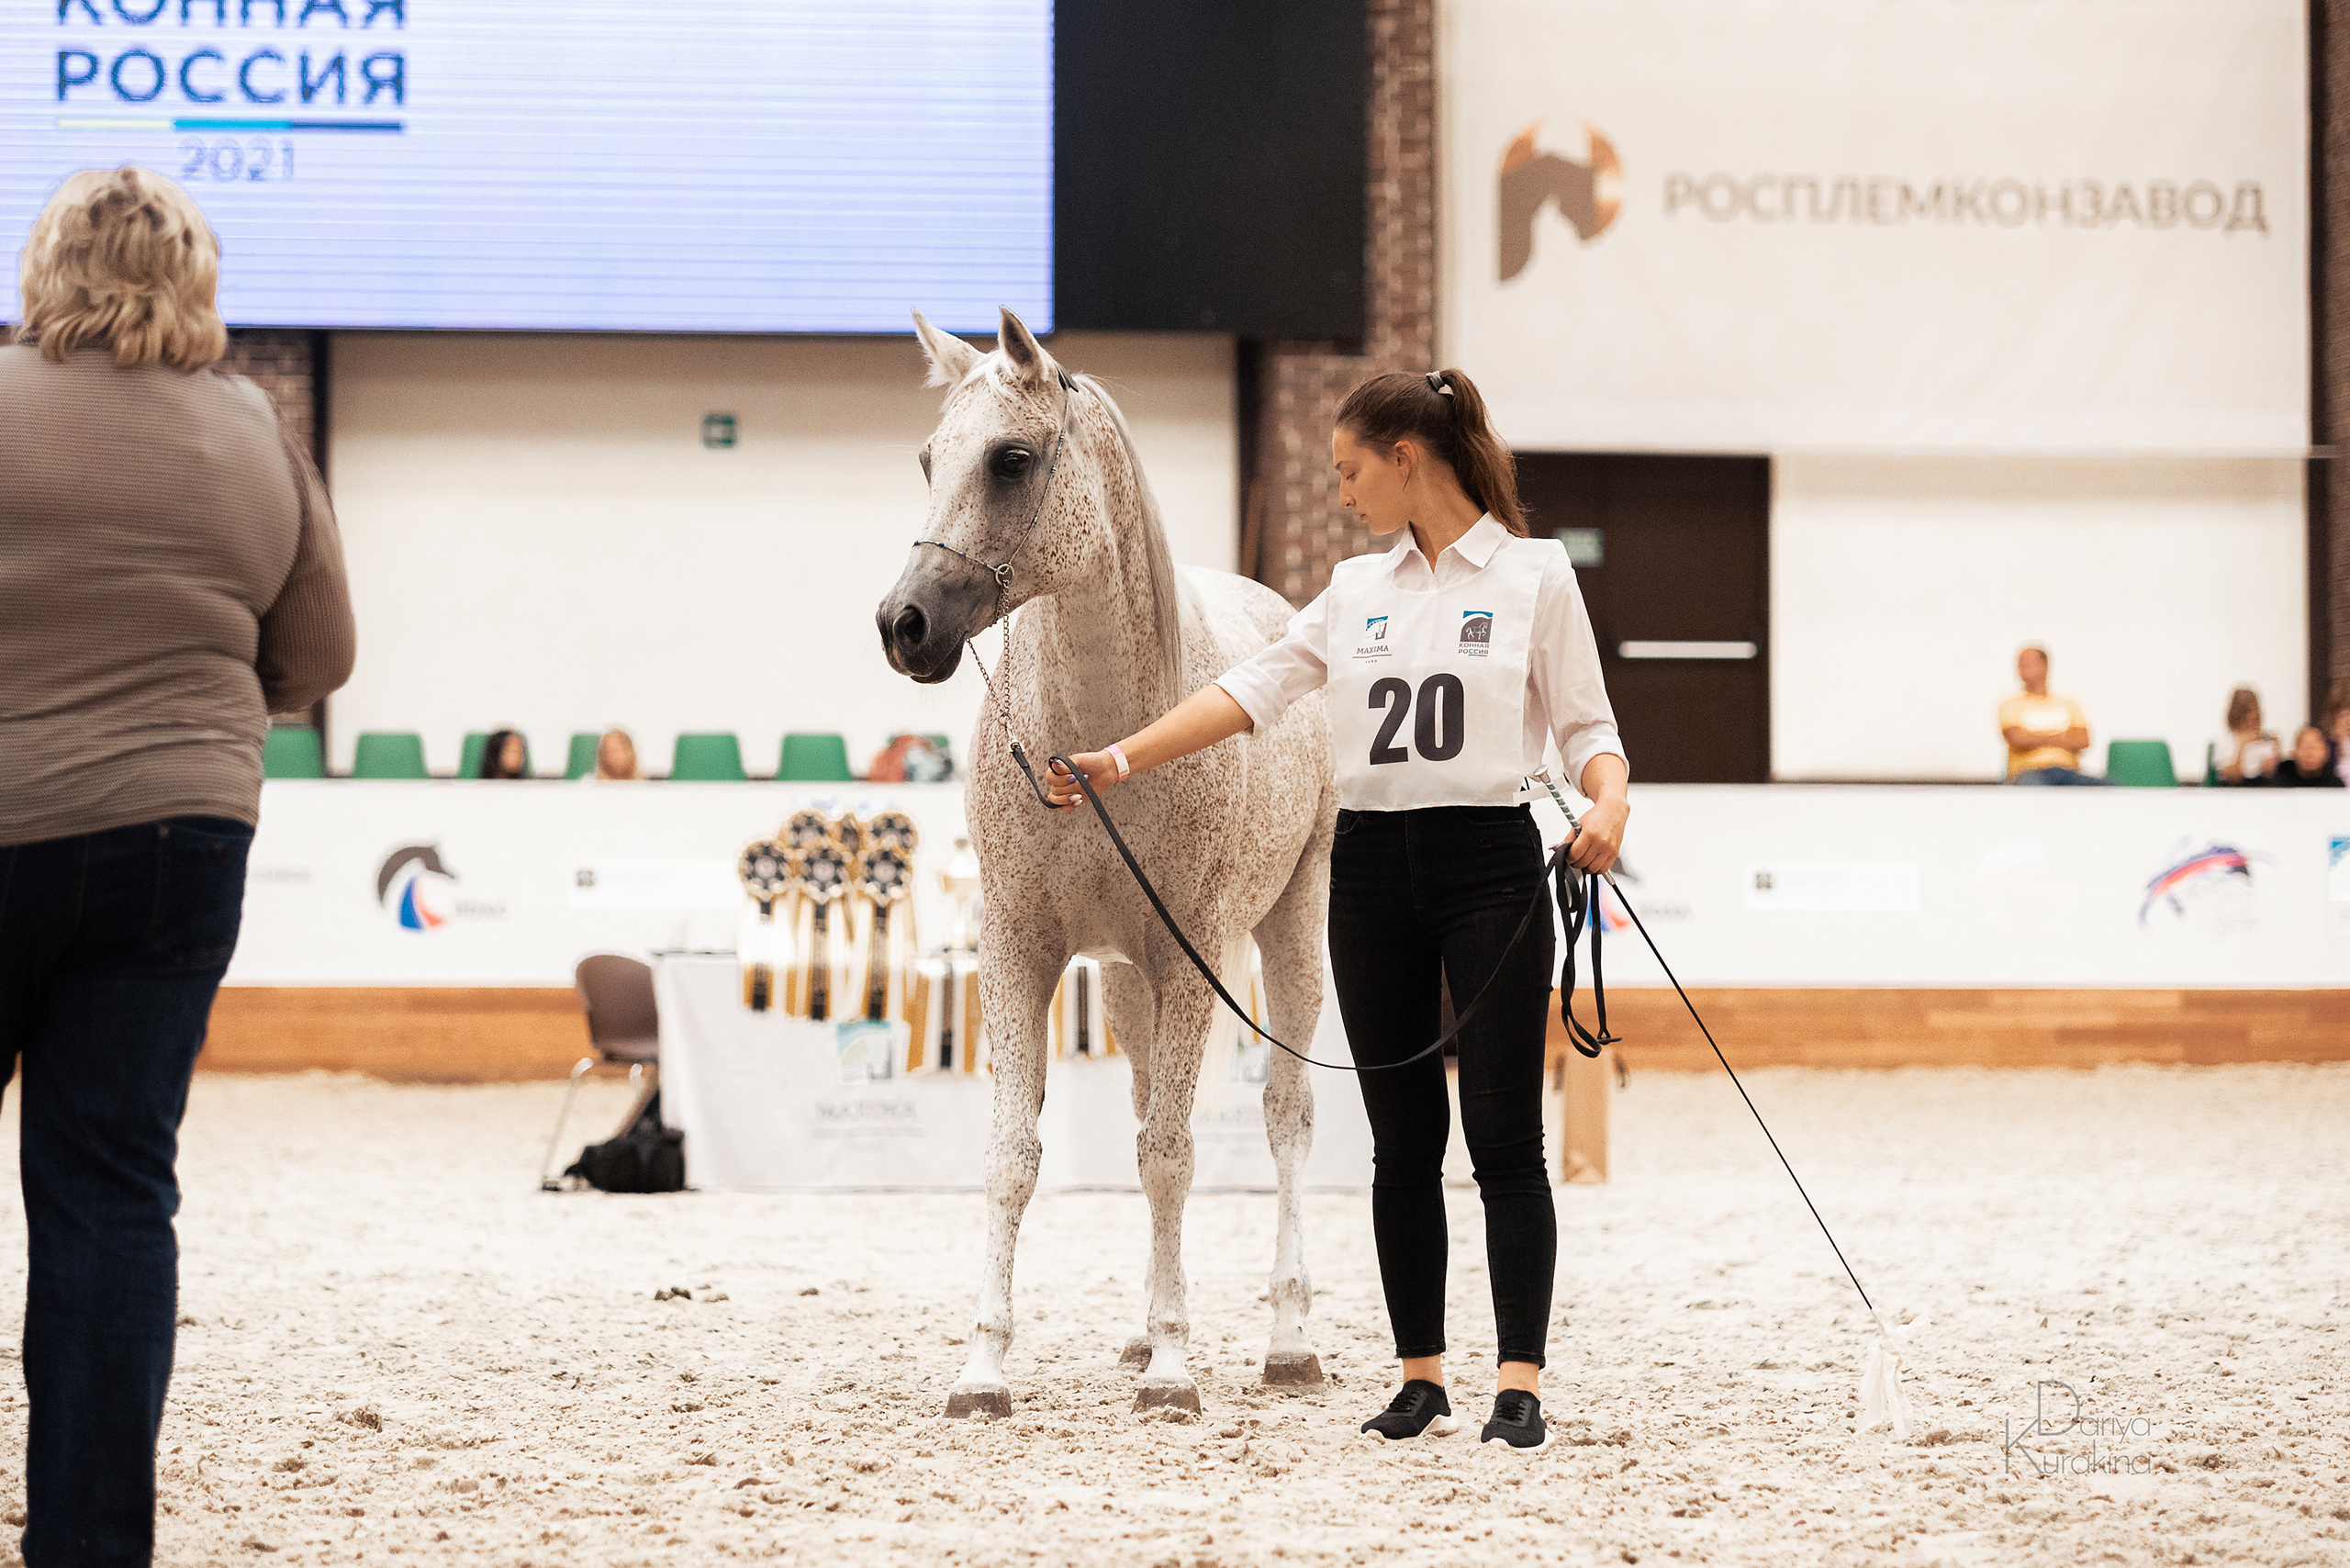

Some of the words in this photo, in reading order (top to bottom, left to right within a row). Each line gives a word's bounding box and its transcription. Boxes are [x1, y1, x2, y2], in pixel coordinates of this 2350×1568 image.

[58, 49, 405, 104] РОССИЯ
[181, 137, 294, 181] 2021
[1662, 171, 2270, 239] РОСПЛЕМКОНЗАВОД
[1357, 644, 1389, 655] MAXIMA
[1368, 672, 1465, 766] 20
